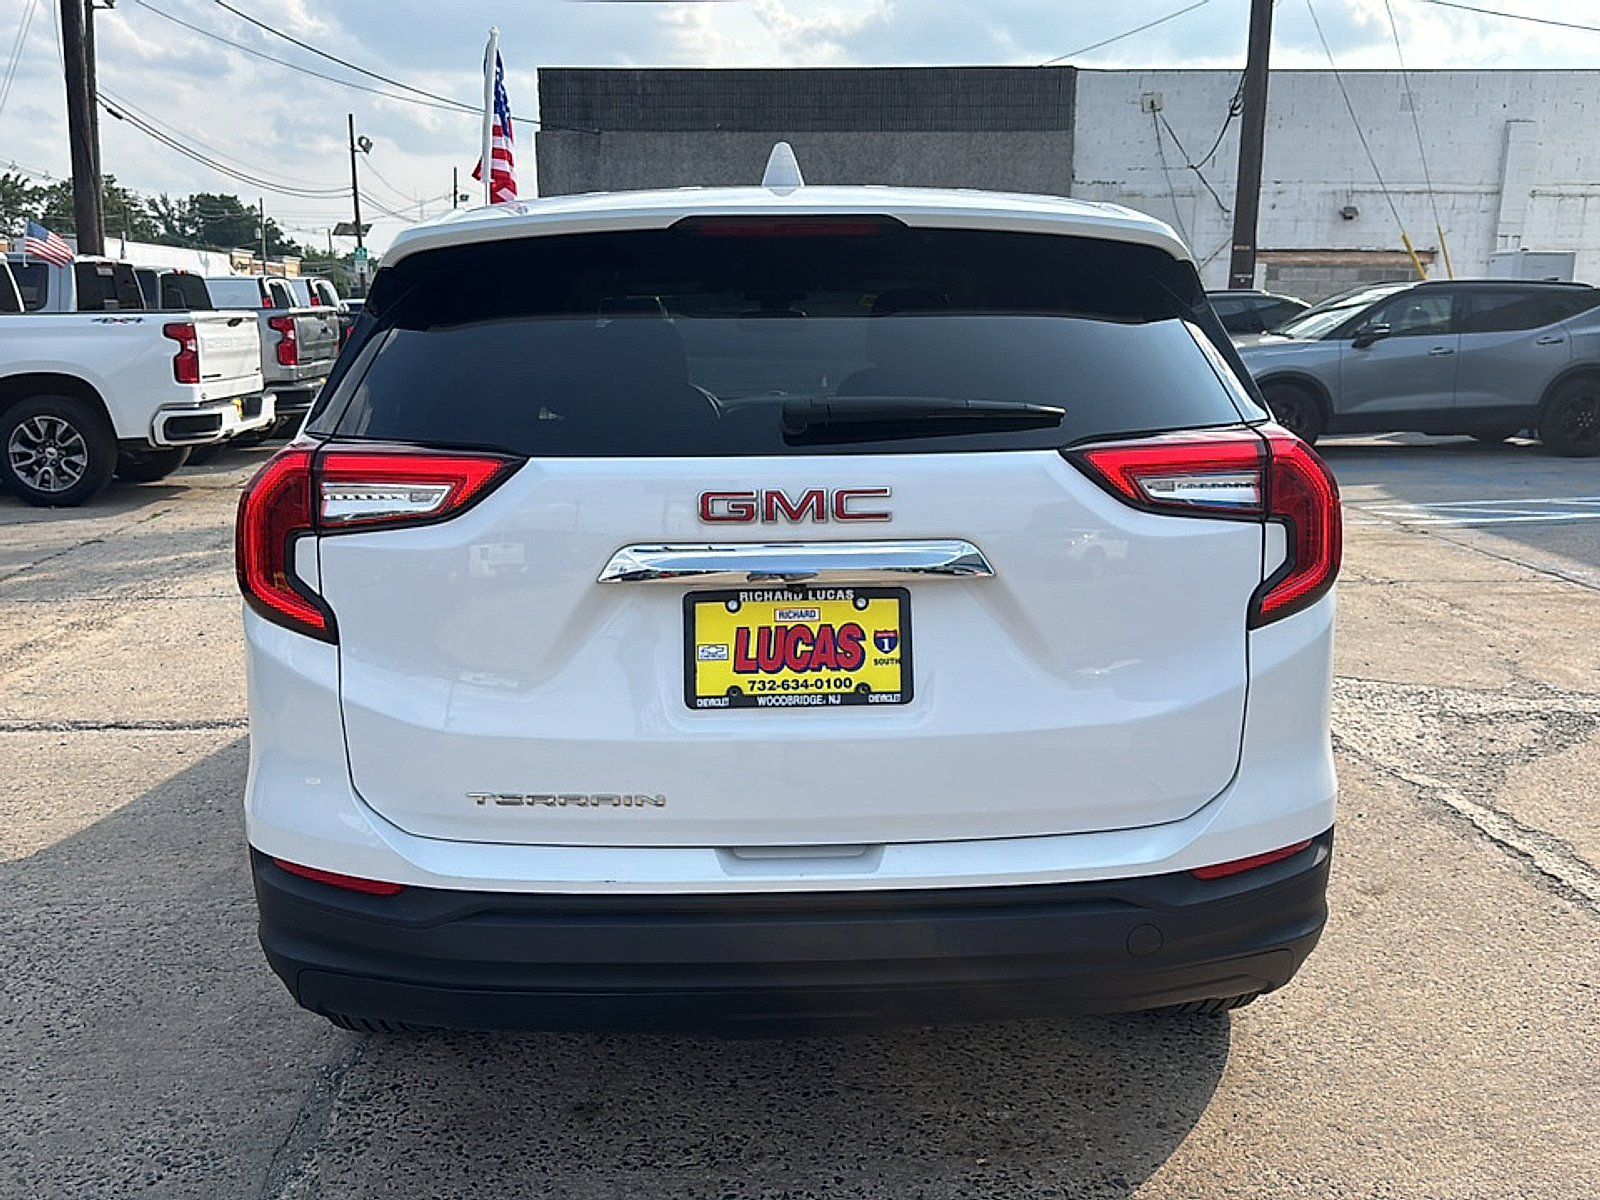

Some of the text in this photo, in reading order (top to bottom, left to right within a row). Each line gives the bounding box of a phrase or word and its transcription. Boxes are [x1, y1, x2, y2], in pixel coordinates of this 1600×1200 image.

[698, 487, 892, 524] GMC
[739, 589, 855, 602] RICHARD LUCAS
[778, 610, 816, 619] RICHARD
[734, 623, 866, 673] LUCAS
[881, 638, 891, 651] 1
[873, 658, 901, 666] SOUTH
[747, 677, 853, 691] 732-634-0100
[828, 694, 842, 704] NJ
[466, 791, 667, 807] TERRAIN
